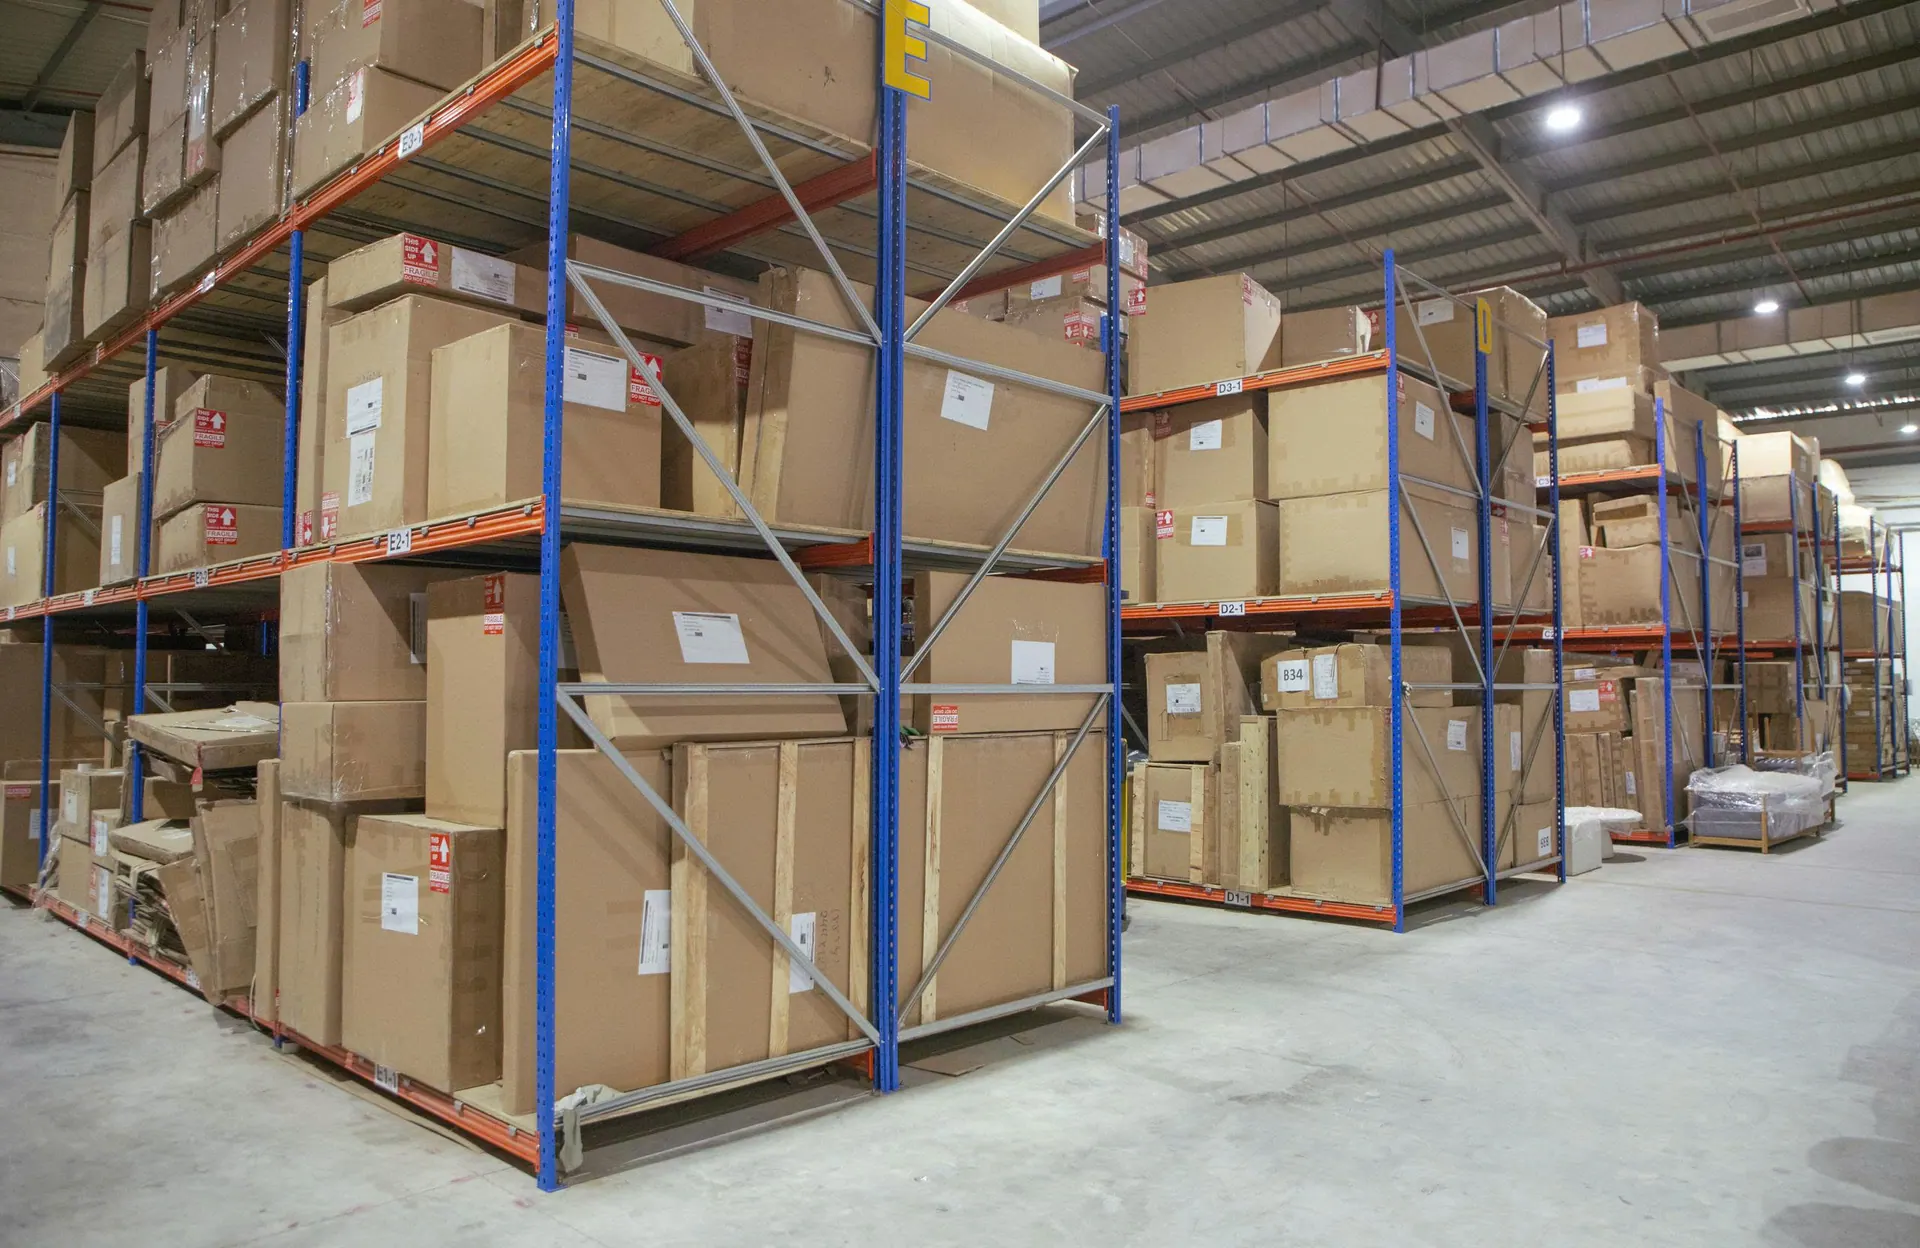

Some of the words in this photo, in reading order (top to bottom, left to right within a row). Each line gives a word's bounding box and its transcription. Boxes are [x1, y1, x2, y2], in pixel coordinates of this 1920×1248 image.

[883, 0, 931, 101] E
[402, 130, 421, 152] E3-1
[405, 245, 419, 253] SIDE
[404, 266, 438, 278] FRAGILE
[1477, 296, 1491, 354] D
[1219, 381, 1241, 393] D3-1
[390, 531, 409, 551] E2-1
[1221, 603, 1243, 614] D2-1
[1283, 669, 1303, 681] B34
[1227, 892, 1249, 904] D1-1
